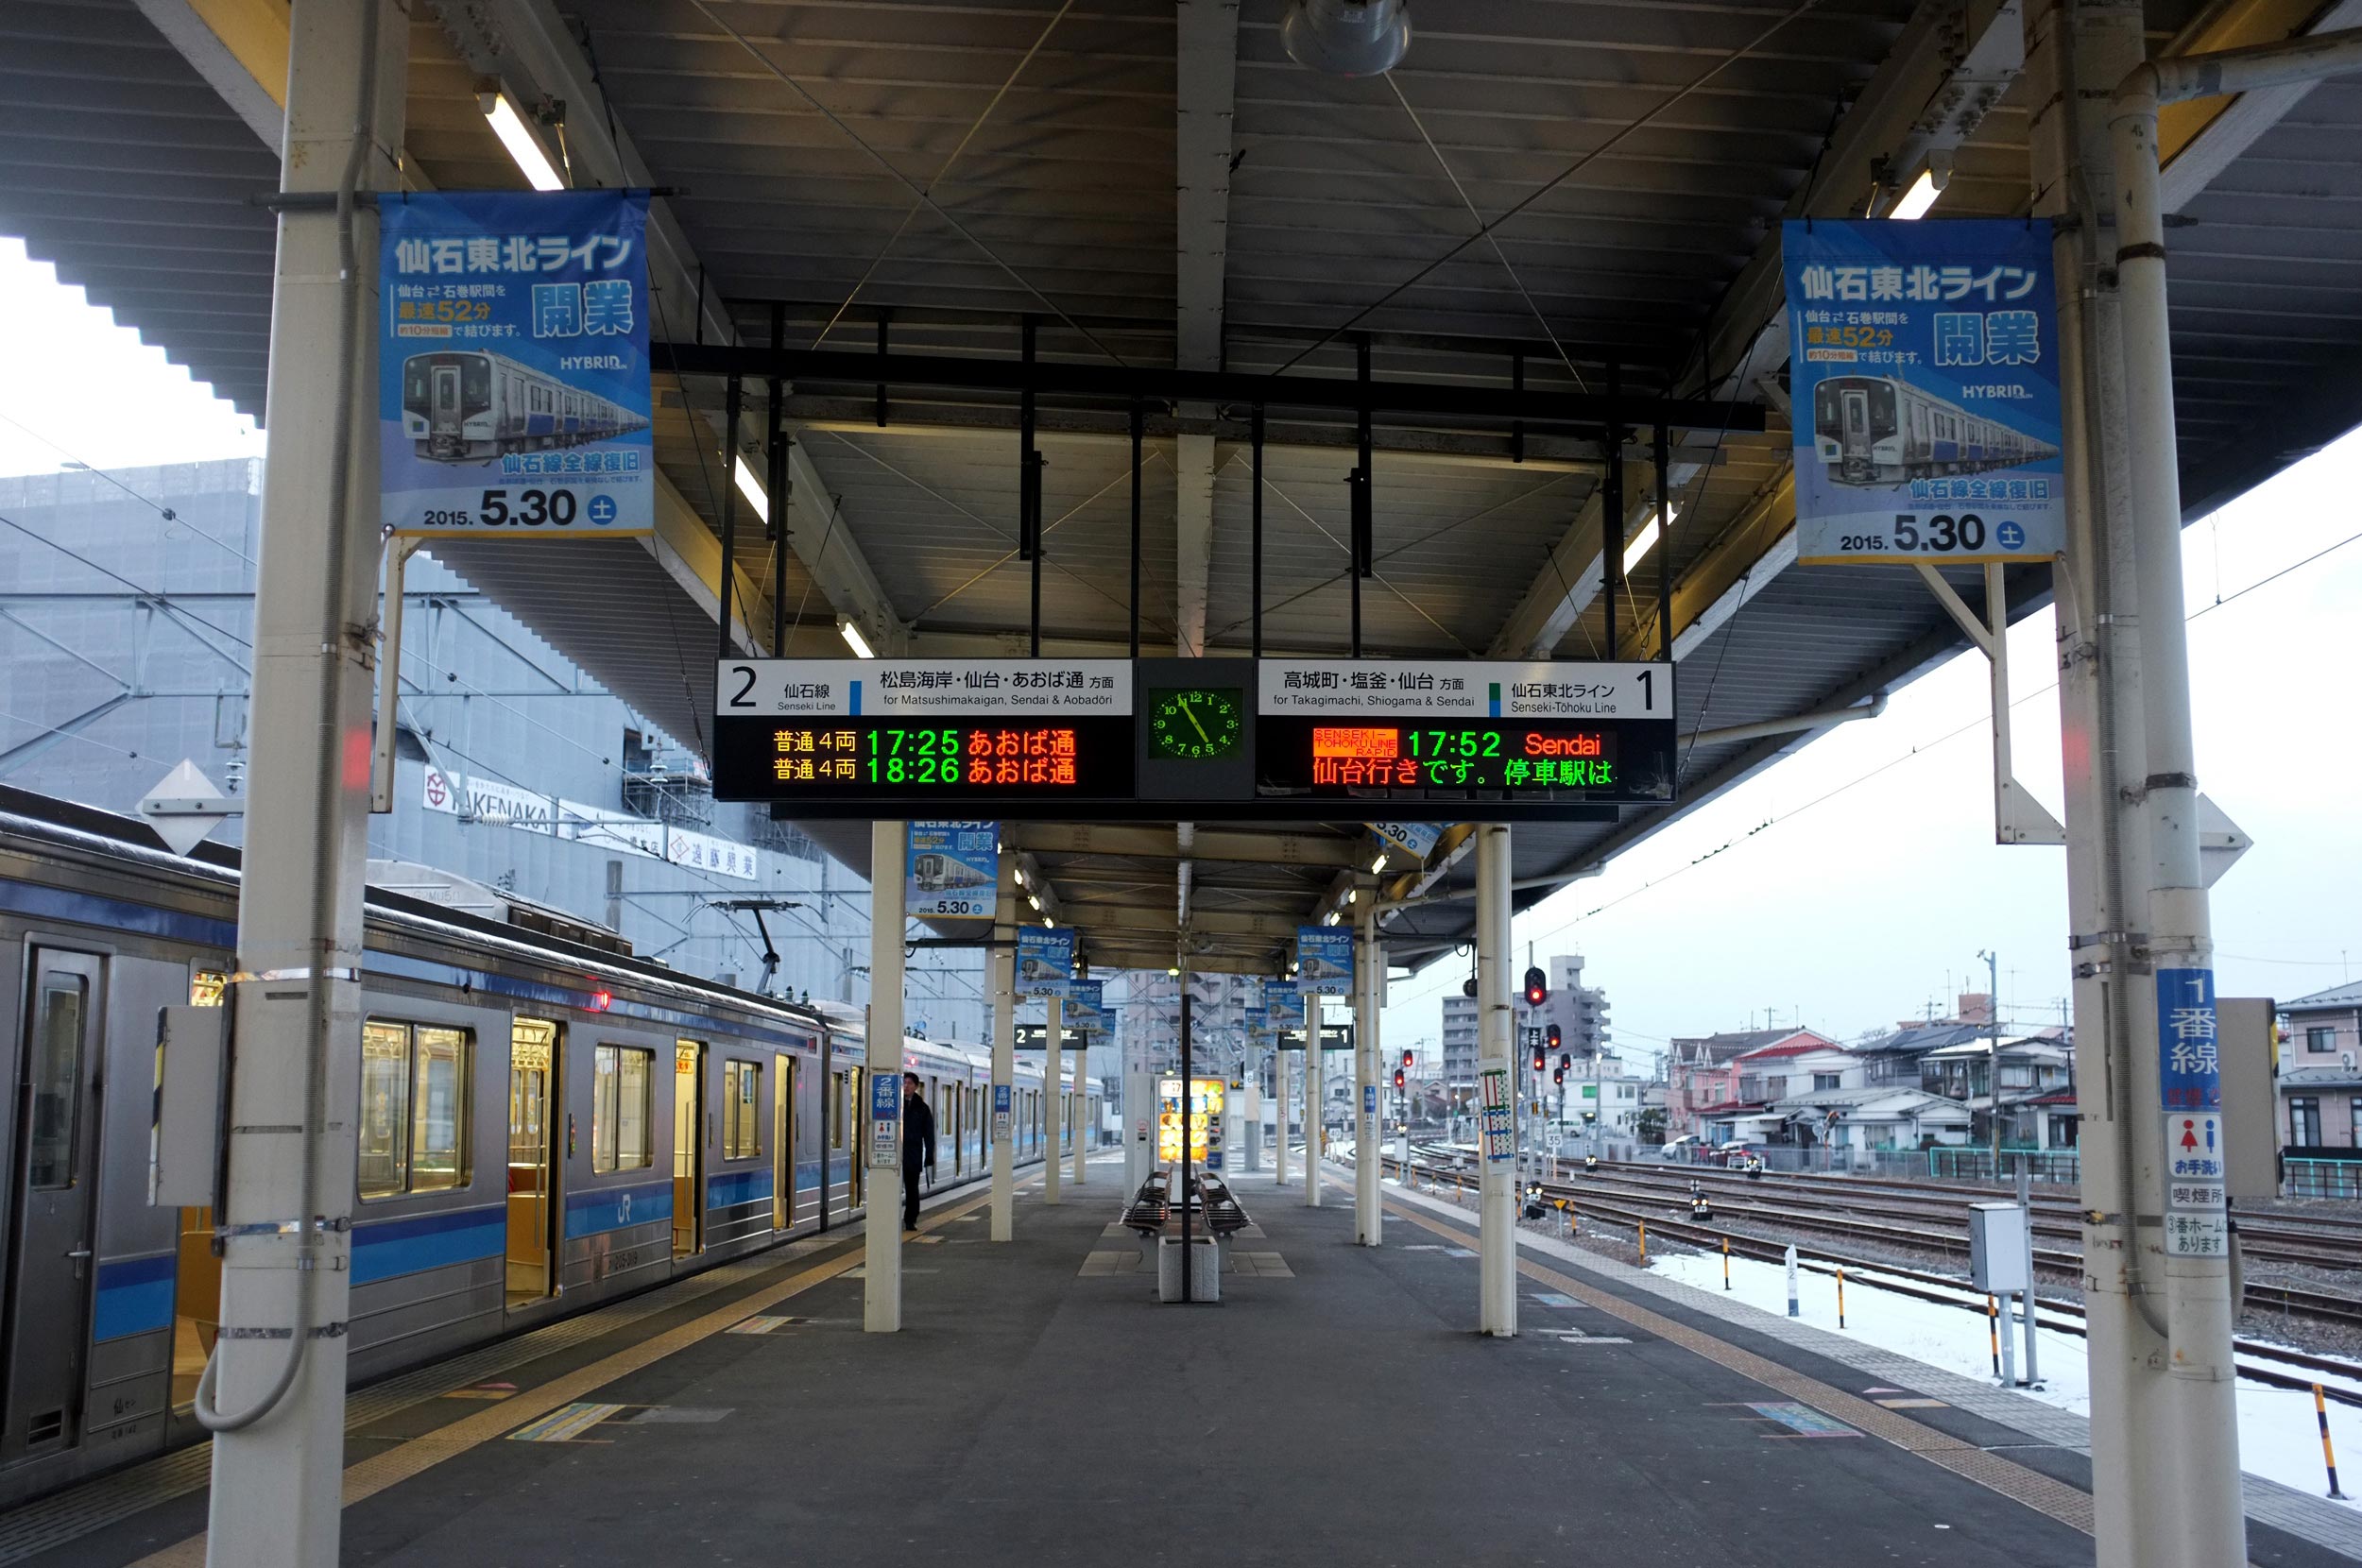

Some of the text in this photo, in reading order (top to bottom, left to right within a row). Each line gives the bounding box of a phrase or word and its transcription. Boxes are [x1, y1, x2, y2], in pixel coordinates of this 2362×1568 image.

[395, 236, 631, 273] 仙石東北ライン
[1801, 265, 2037, 301] 仙石東北ライン
[398, 300, 491, 322] 最速52分
[532, 280, 635, 338] 開業
[1806, 326, 1894, 348] 最速52分
[1933, 310, 2041, 366] 開業
[560, 355, 620, 370] HYBRID
[1962, 384, 2025, 400] HYBRID
[502, 451, 641, 476] 仙石線全線復旧
[1909, 478, 2050, 502] 仙石線全線復旧
[424, 489, 577, 527] 2015. 5.30
[591, 500, 612, 519] 土
[1840, 513, 1986, 553] 2015. 5.30
[2000, 525, 2022, 545] 土
[729, 666, 757, 707] 2
[880, 671, 1114, 690] 松島海岸・仙台・あおば通 方面
[1283, 671, 1464, 690] 高城町・塩釜・仙台 方面
[784, 684, 830, 699] 仙石線
[1512, 683, 1616, 699] 仙石東北ライン
[1635, 671, 1653, 710] 1
[778, 702, 836, 710] Senseki Line
[883, 694, 1113, 707] for Matsushimakaigan, Sendai & Aobadōri
[1274, 695, 1475, 709] for Takagimachi, Shiogama & Sendai
[1512, 701, 1617, 715] Senseki-Tōhoku Line
[1219, 705, 1227, 713] 2
[1157, 720, 1166, 728] 9
[1226, 720, 1235, 728] 3
[867, 730, 959, 756] 17:25
[968, 729, 1077, 756] あおば通
[1164, 735, 1172, 743] 8
[1219, 735, 1227, 743] 4
[1409, 731, 1600, 757] 17:52 Sendai
[1178, 743, 1186, 752] 7
[1191, 746, 1200, 755] 6
[1206, 743, 1214, 752] 5
[867, 758, 959, 784] 18:26
[968, 758, 1077, 784] あおば通
[958, 832, 993, 851] 開業
[937, 901, 969, 914] 5.30
[1034, 987, 1053, 996] 5.30
[1316, 986, 1336, 995] 5.30
[2169, 979, 2218, 1074] 1番線
[1017, 1029, 1026, 1043] 2
[1341, 1029, 1347, 1043] 1
[876, 1078, 896, 1108] 2番線
[1548, 1135, 1561, 1146] 35
[2175, 1160, 2222, 1175] お手洗い
[2173, 1188, 2223, 1203] 喫煙所
[618, 1194, 631, 1224] JR
[2179, 1236, 2222, 1253] あります
